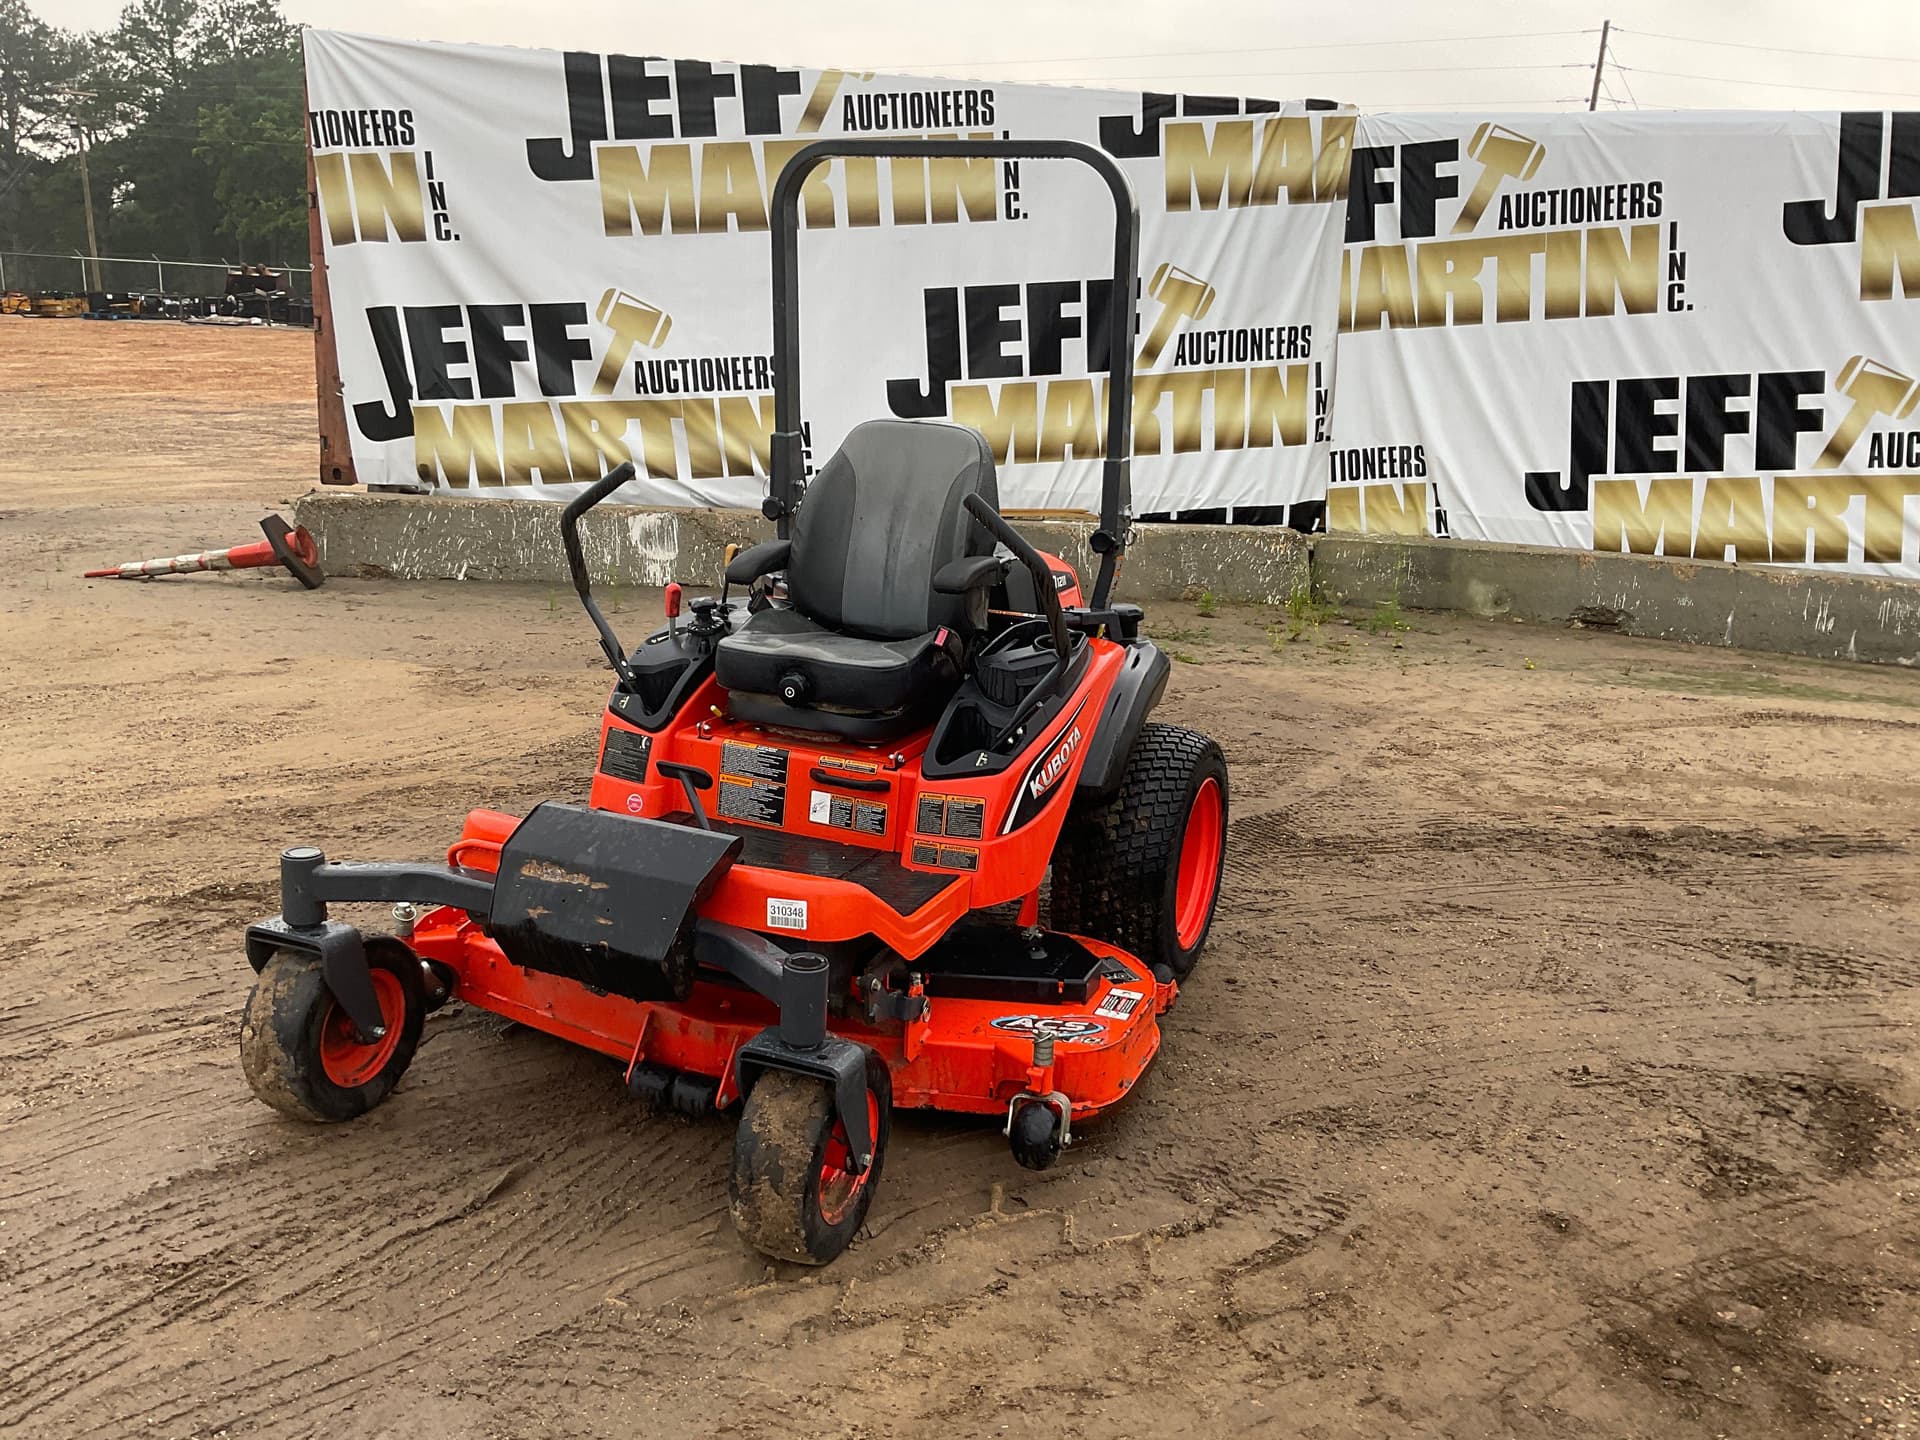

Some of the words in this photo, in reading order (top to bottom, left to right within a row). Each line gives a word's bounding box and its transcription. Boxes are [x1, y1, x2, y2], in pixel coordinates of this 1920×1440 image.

[526, 52, 801, 181] JEFF
[843, 89, 995, 131] AUCTIONEERS
[424, 151, 460, 241] INC.
[1498, 181, 1663, 230] AUCTIONEERS
[1338, 223, 1660, 333] ARTIN
[1667, 221, 1694, 312] INC.
[353, 303, 593, 442] JEFF
[1174, 325, 1312, 366] AUCTIONEERS
[1525, 371, 1826, 511] JEFF
[1030, 726, 1081, 800] KUBOTA
[770, 905, 804, 918] 310348
[1006, 1017, 1090, 1033] ACS
